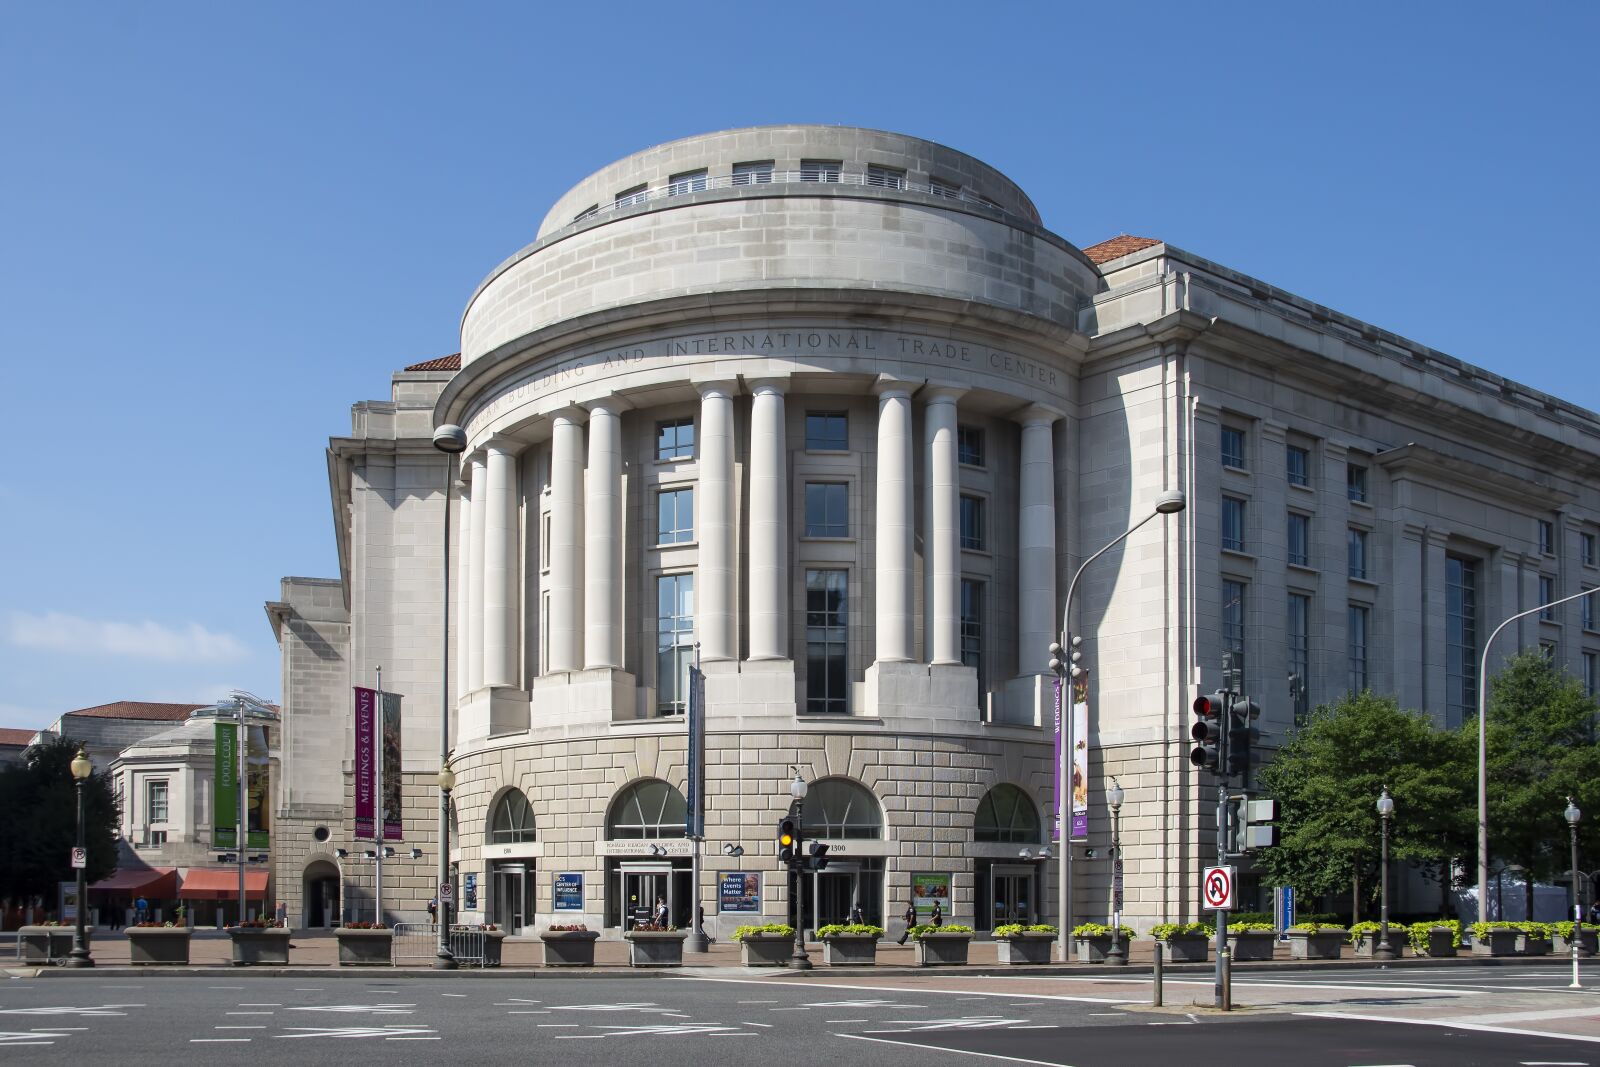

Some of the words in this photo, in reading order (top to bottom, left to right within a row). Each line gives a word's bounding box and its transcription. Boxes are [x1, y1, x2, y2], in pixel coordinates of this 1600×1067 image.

[508, 362, 585, 403] BUILDING
[602, 349, 645, 370] AND
[665, 333, 877, 358] INTERNATIONAL
[897, 338, 971, 362] TRADE
[990, 353, 1057, 386] CENTER
[360, 691, 369, 732] EVENTS
[222, 728, 231, 758] COURT
[360, 735, 369, 744] &
[222, 761, 231, 787] FOOD
[360, 747, 369, 804] MEETINGS
[831, 844, 846, 852] 1300
